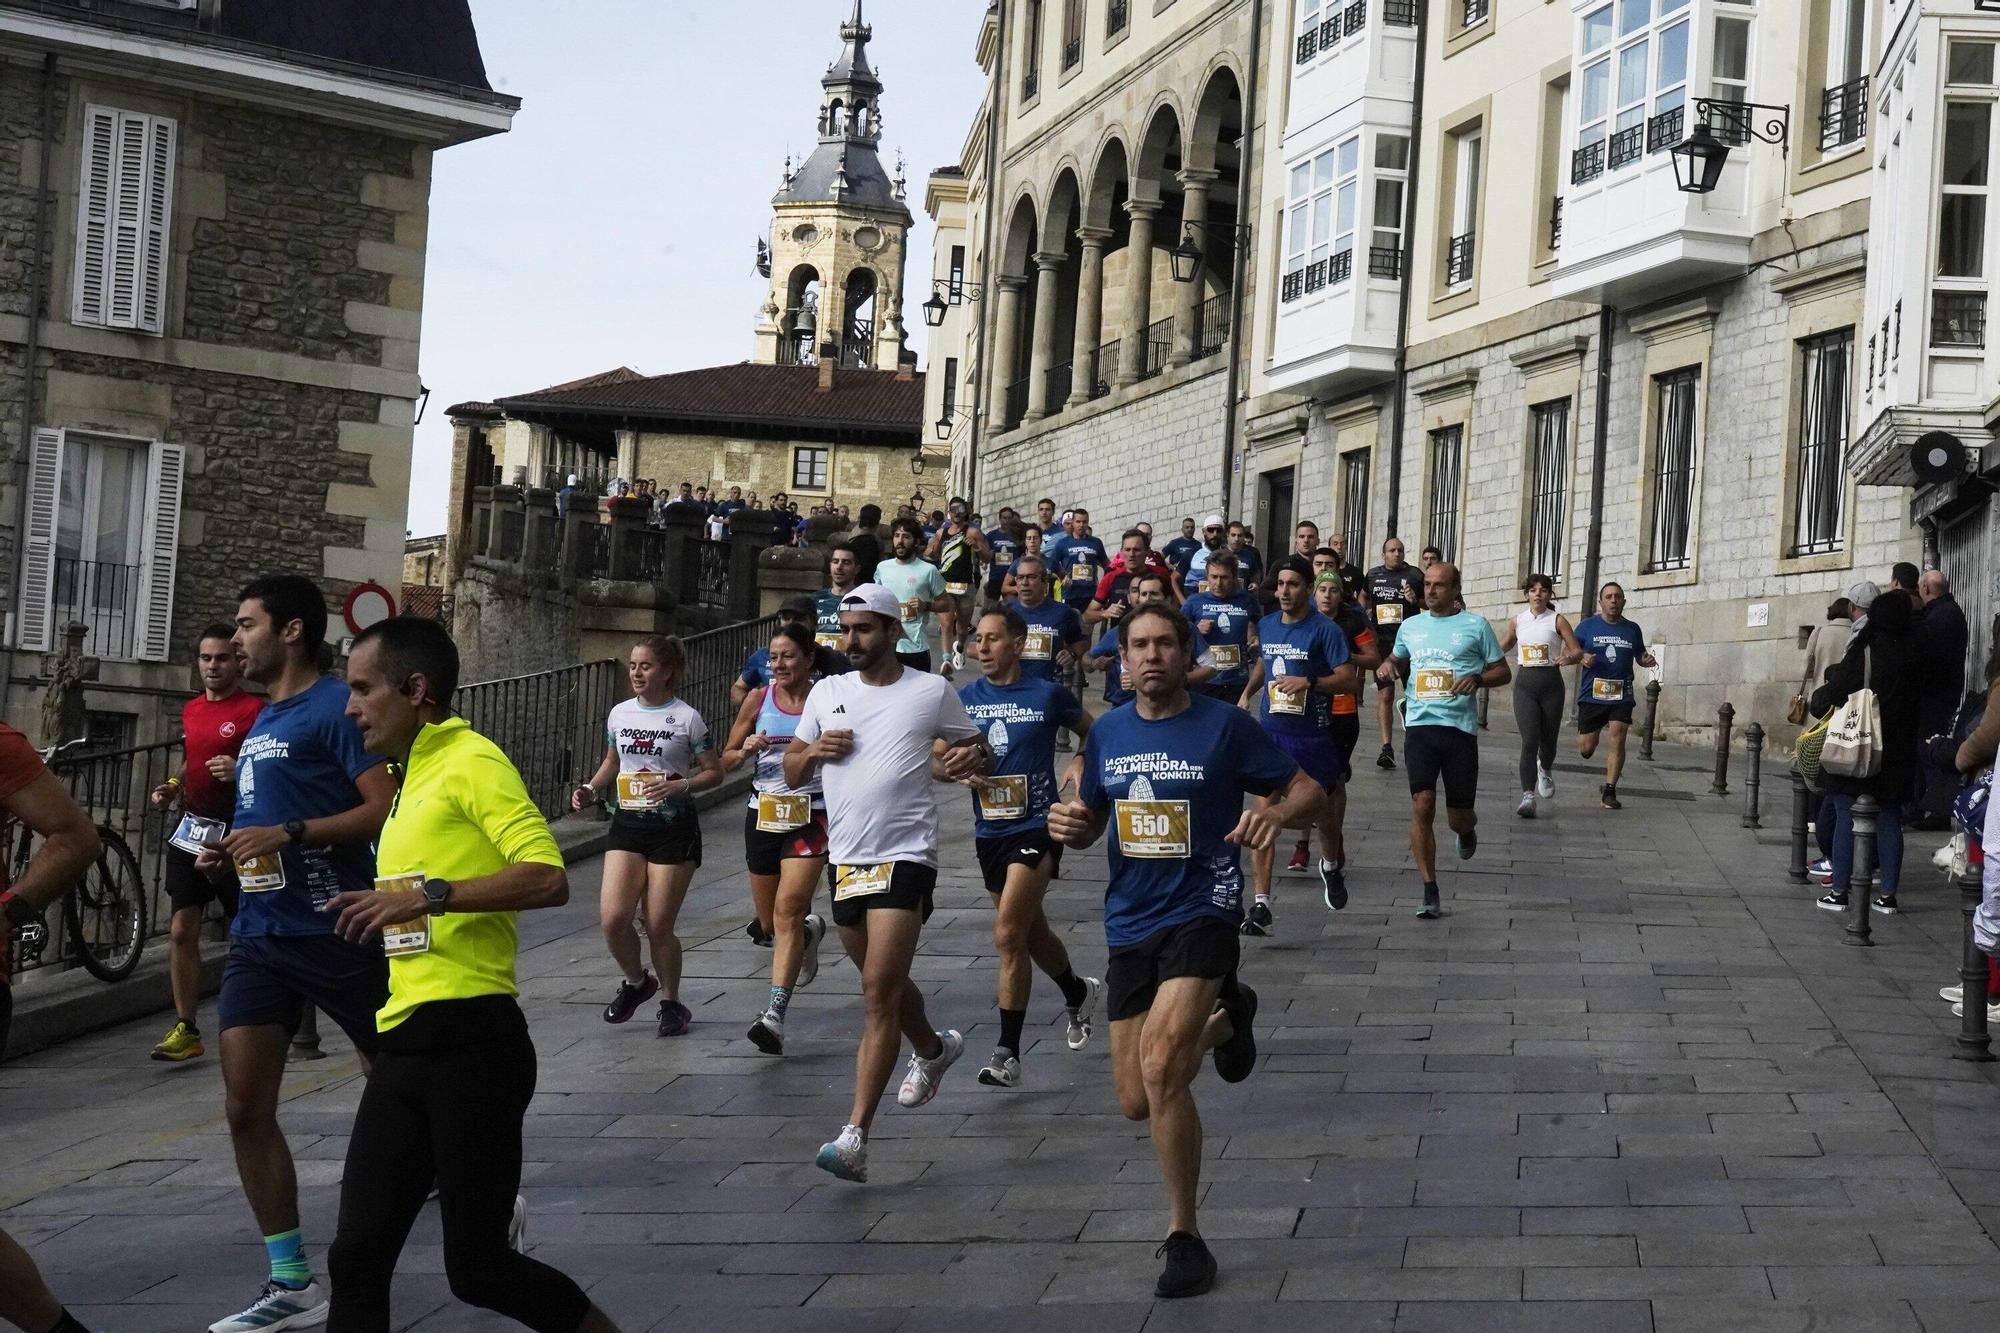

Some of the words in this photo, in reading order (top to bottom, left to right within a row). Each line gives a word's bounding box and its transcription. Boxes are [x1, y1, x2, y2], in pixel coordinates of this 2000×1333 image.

[1425, 676, 1443, 688] 407
[975, 703, 1018, 711] CONQUISTA
[976, 707, 1034, 719] ALMENDRA
[1006, 715, 1045, 724] KONKISTA
[620, 728, 675, 740] SORGINAK
[620, 744, 663, 757] TALDEA
[1114, 752, 1168, 766] CONQUISTA
[1114, 760, 1190, 776] ALMENDRA
[1152, 771, 1204, 781] KONKISTA
[775, 803, 791, 818] 57
[1131, 814, 1170, 836] 550
